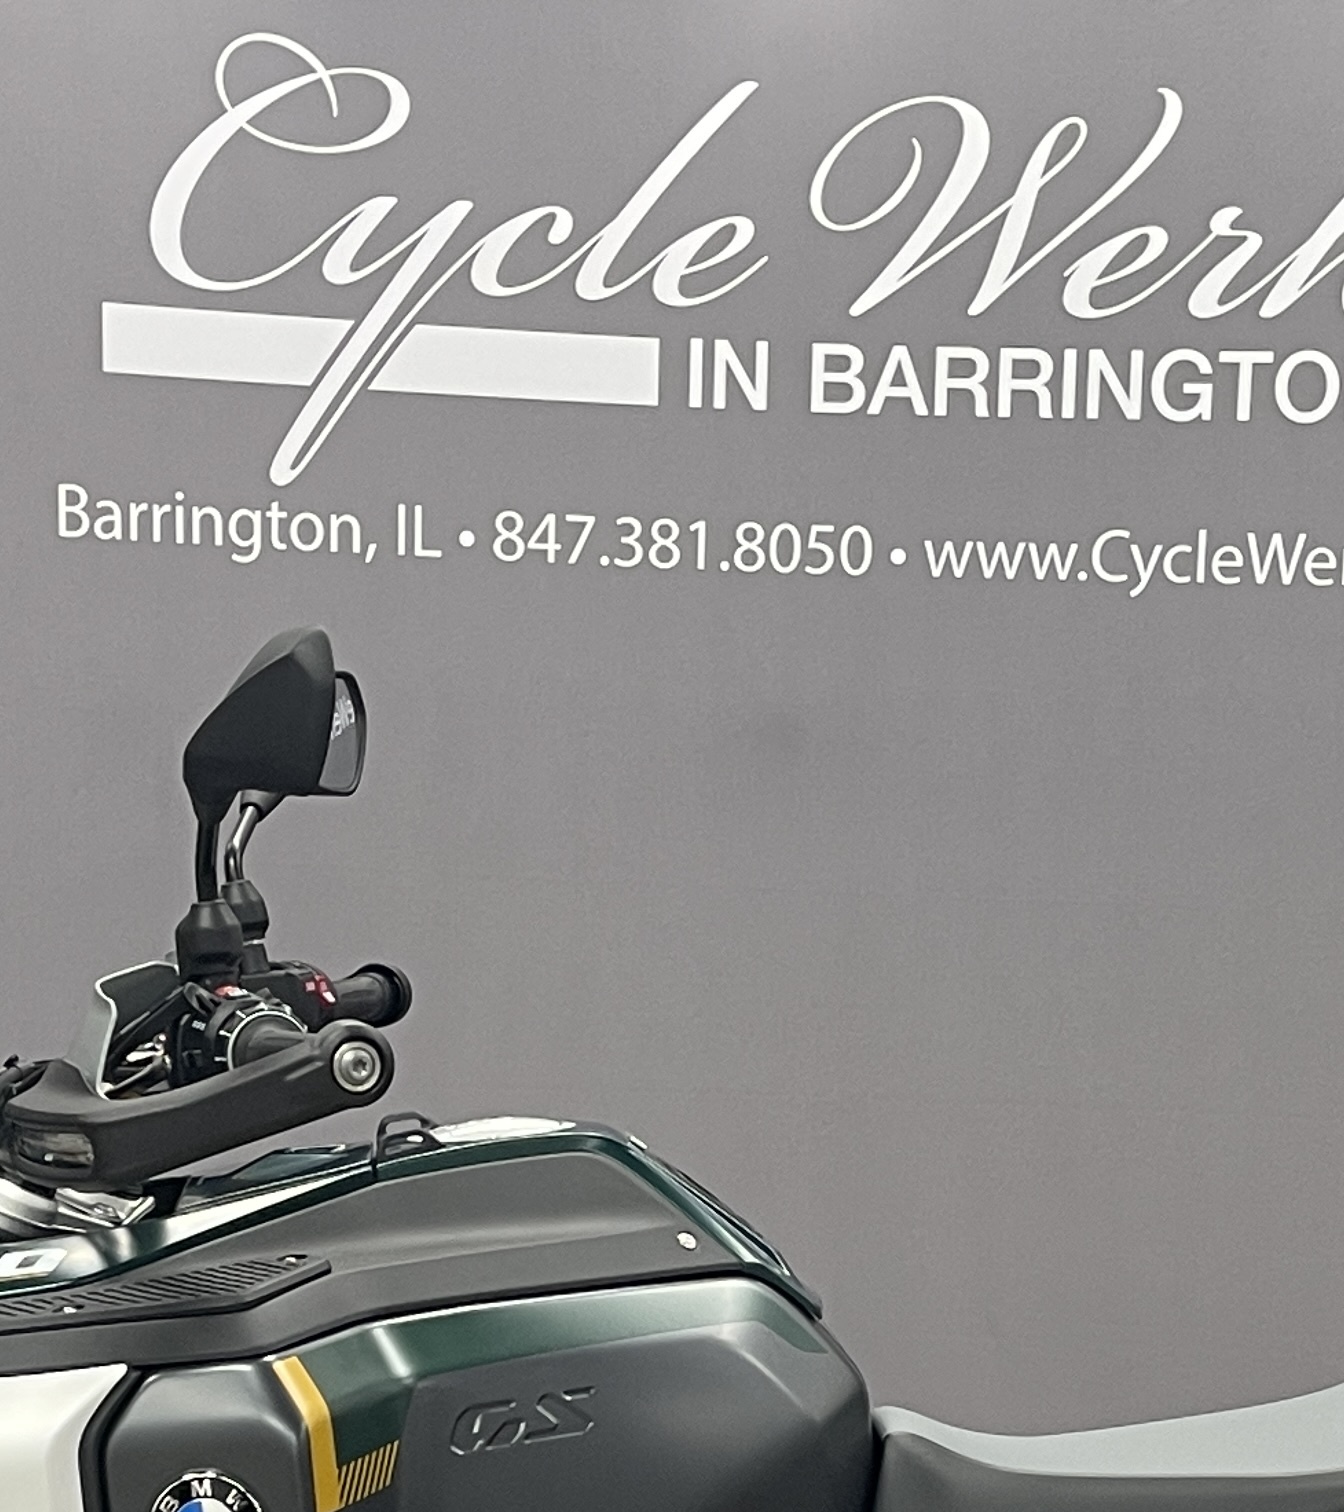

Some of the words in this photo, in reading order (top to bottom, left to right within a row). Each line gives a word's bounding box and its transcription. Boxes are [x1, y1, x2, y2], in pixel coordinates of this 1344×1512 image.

[149, 32, 769, 487] Cycle
[688, 337, 770, 412] IN
[58, 483, 378, 565] Barrington,
[396, 503, 443, 558] IL
[492, 510, 874, 577] 847.381.8050
[450, 1385, 597, 1456] GS
